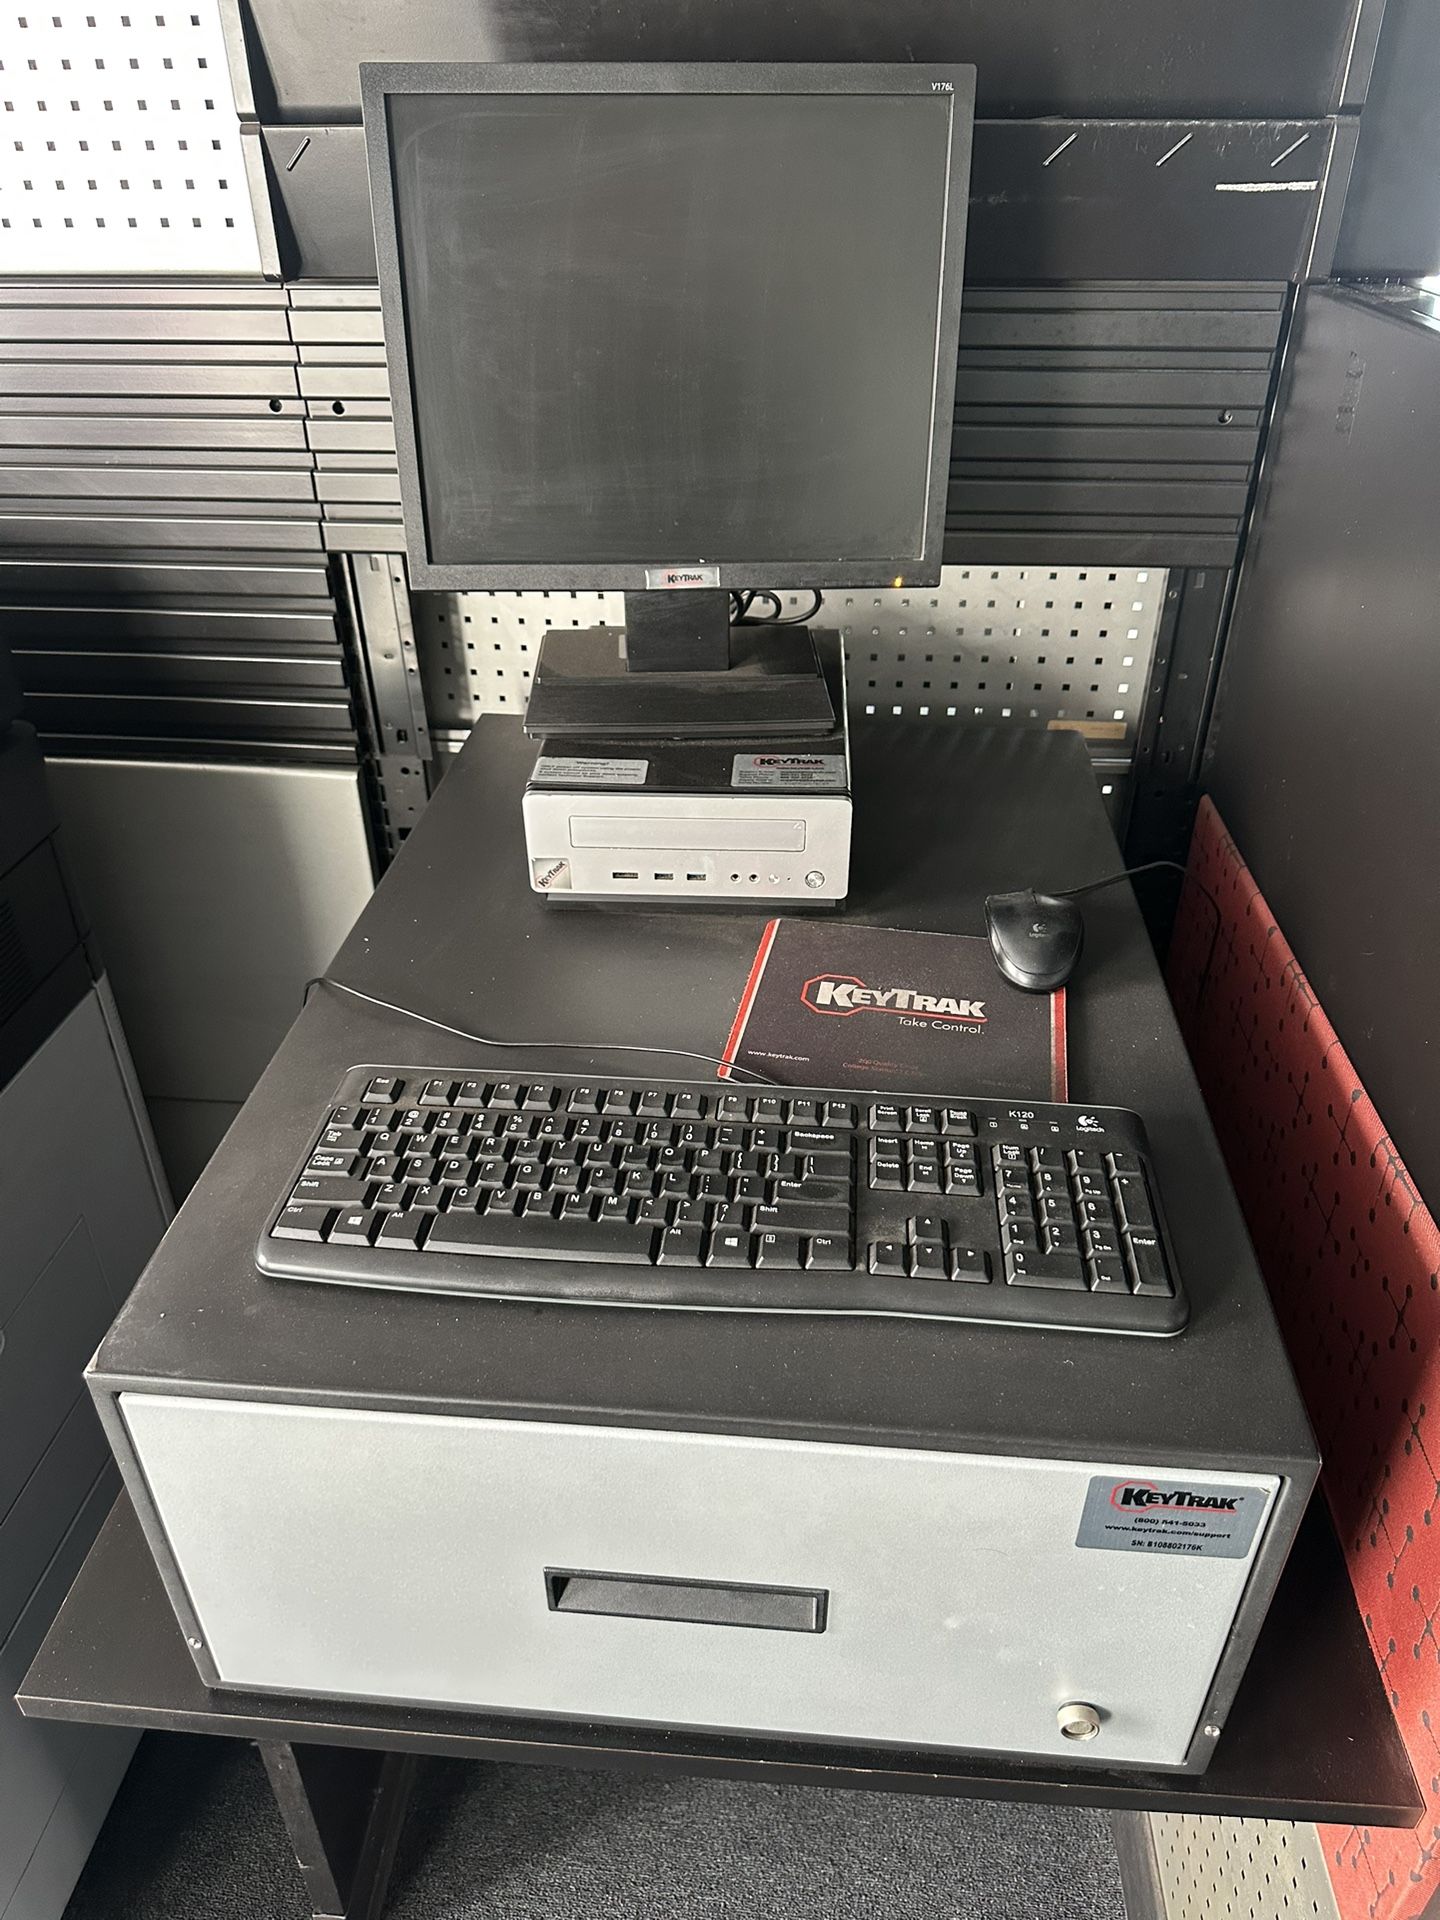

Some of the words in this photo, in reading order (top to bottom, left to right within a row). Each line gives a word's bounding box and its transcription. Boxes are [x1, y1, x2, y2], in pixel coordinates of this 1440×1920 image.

[931, 82, 955, 91] V176L
[899, 1017, 927, 1028] Take
[932, 1020, 985, 1035] Control.
[380, 1133, 389, 1141] Q
[794, 1131, 835, 1140] Backspace
[451, 1136, 459, 1144] E
[523, 1165, 532, 1173] G
[1083, 1176, 1090, 1184] 9
[421, 1186, 431, 1194] X
[497, 1191, 506, 1199] V
[533, 1192, 542, 1200] B
[1009, 1196, 1016, 1204] 4
[1048, 1199, 1056, 1207] 5
[722, 1204, 729, 1212] ?
[1088, 1202, 1095, 1210] 6
[1134, 1517, 1159, 1525] (800)
[1104, 1524, 1231, 1539] www.keytrak.com/support
[1131, 1539, 1145, 1547] SN:
